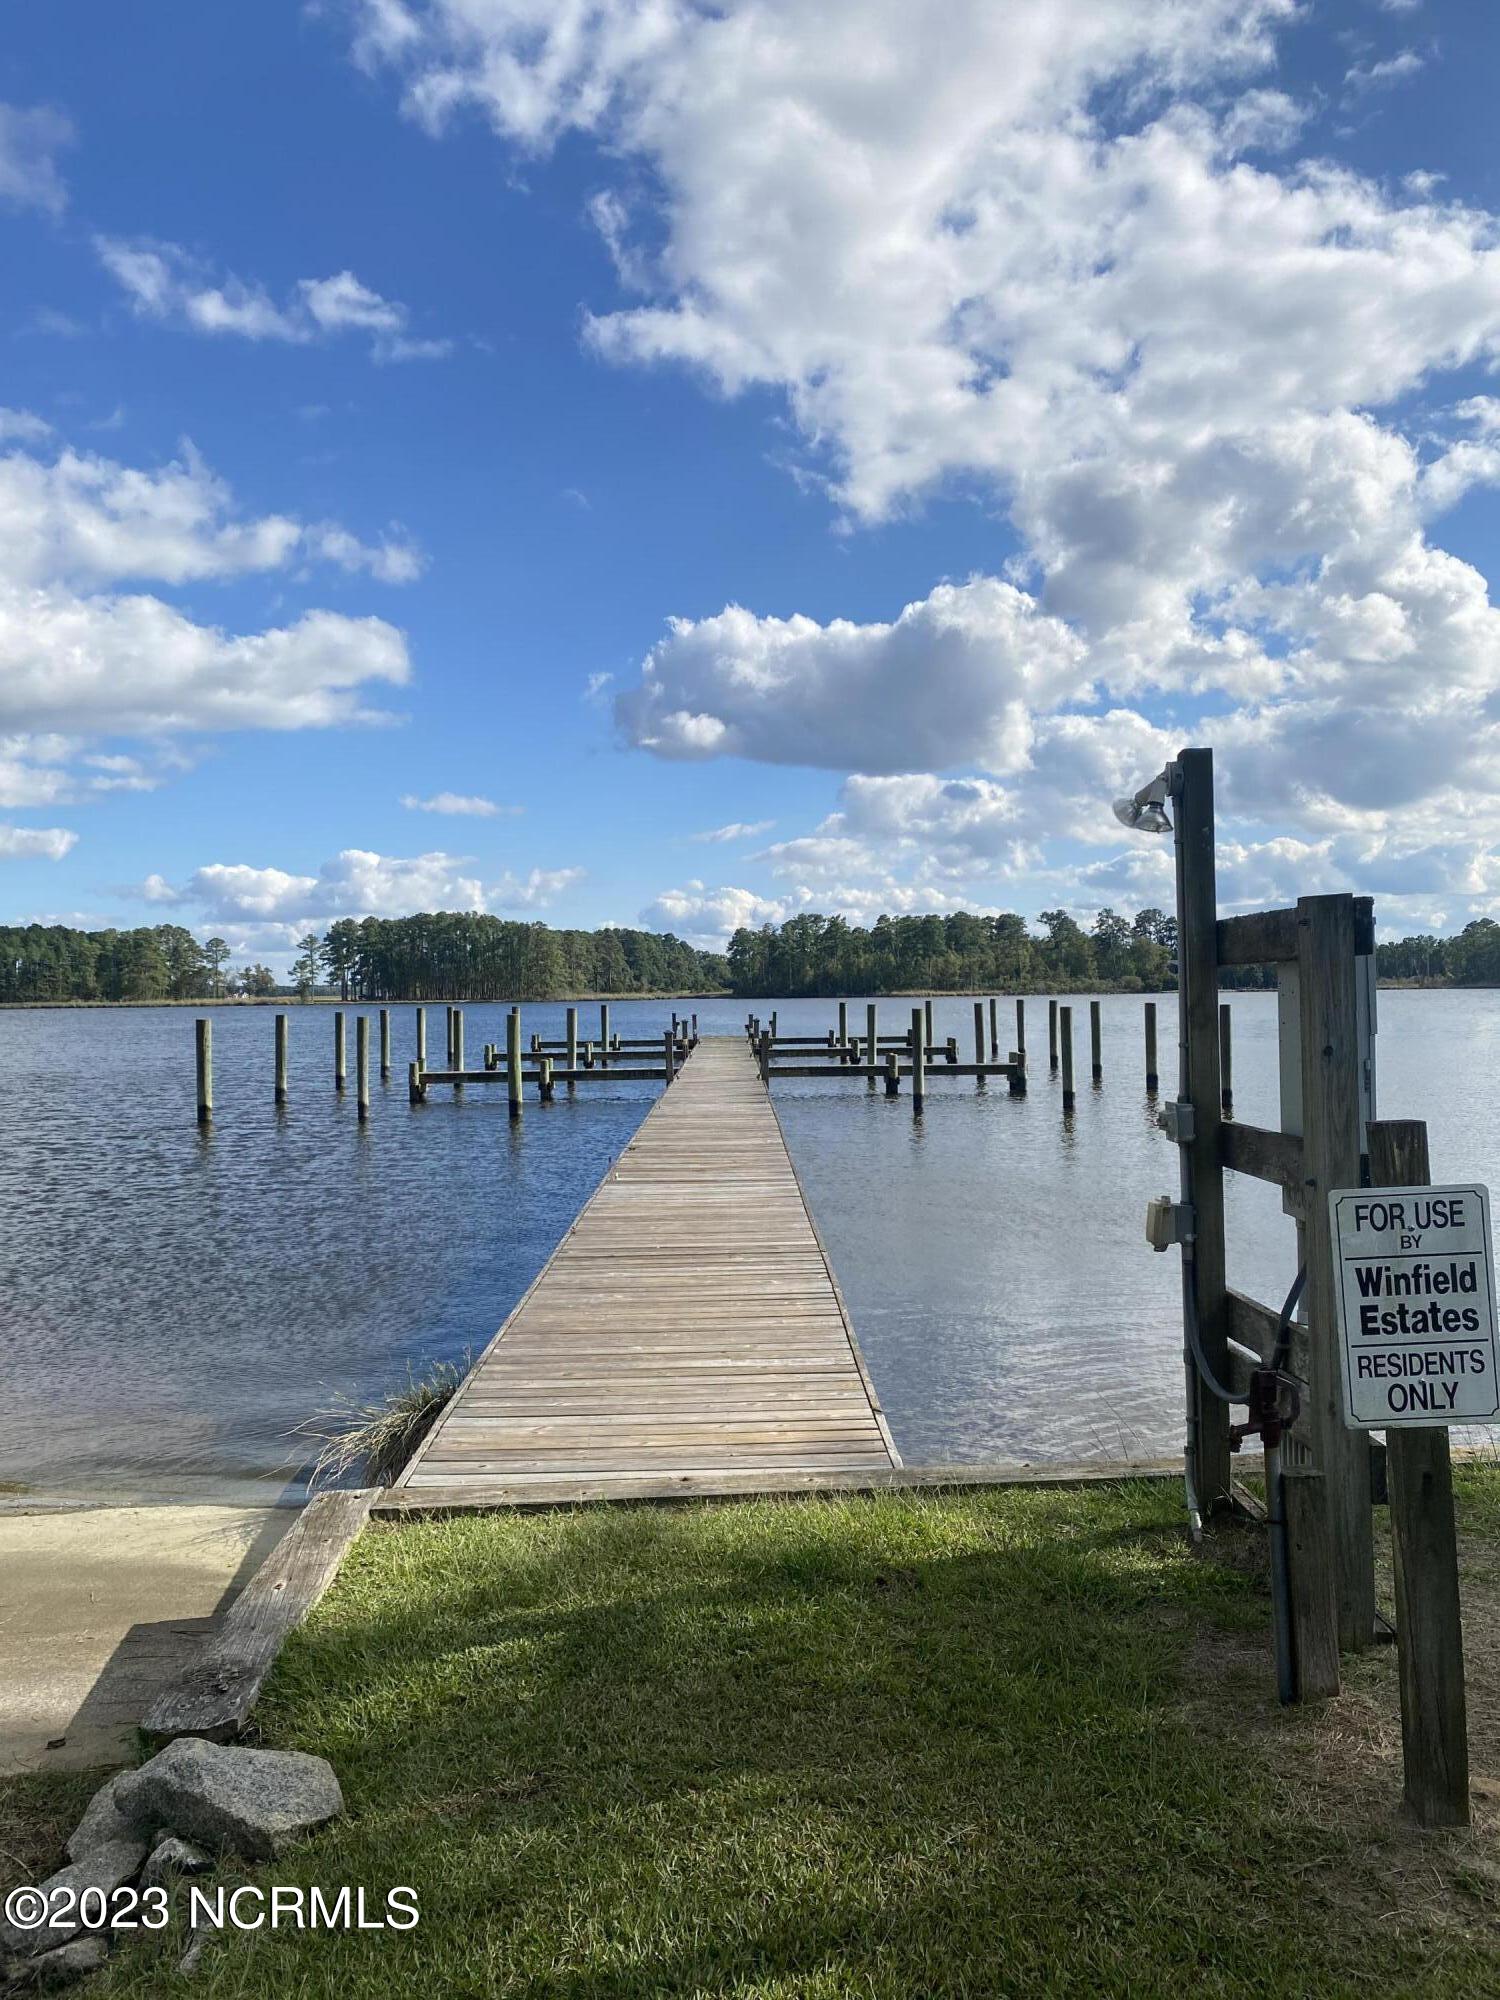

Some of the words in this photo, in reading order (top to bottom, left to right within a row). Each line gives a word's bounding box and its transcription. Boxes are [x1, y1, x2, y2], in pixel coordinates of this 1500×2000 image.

[1354, 1202, 1406, 1232] FOR
[1414, 1200, 1465, 1230] USE
[1400, 1234, 1423, 1249] BY
[1355, 1261, 1477, 1298] Winfield
[1359, 1301, 1480, 1336] Estates
[1357, 1349, 1485, 1379] RESIDENTS
[1387, 1381, 1459, 1413] ONLY
